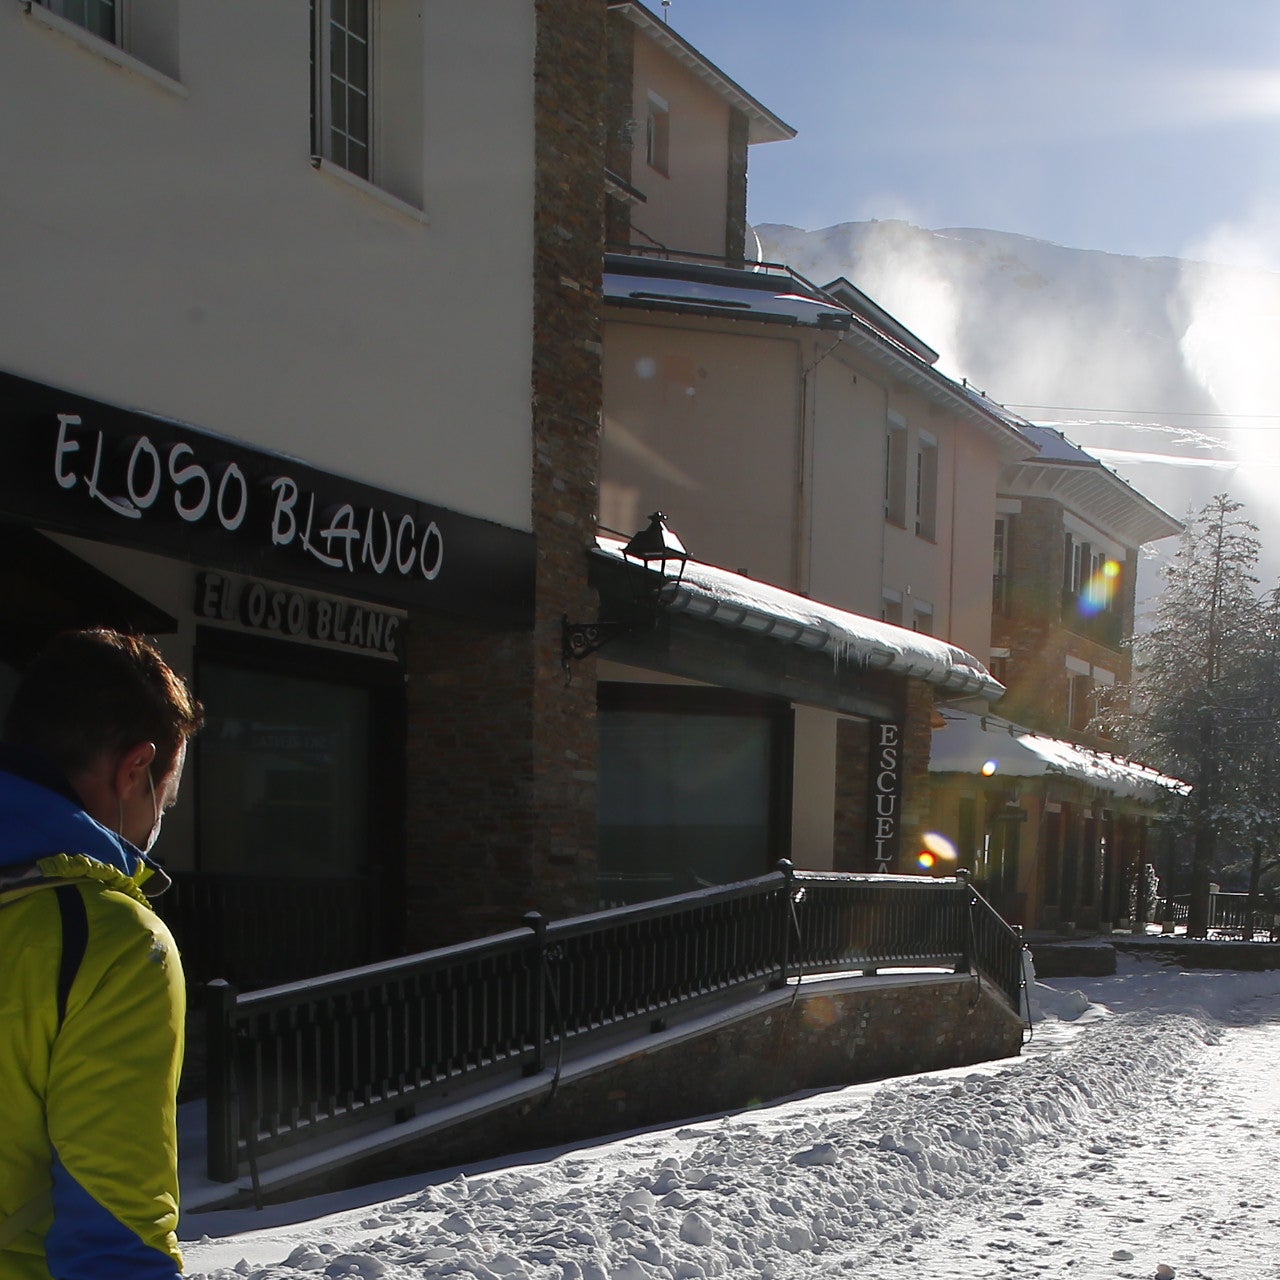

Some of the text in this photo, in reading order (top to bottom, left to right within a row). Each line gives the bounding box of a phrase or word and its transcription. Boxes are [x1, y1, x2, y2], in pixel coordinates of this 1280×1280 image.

[271, 476, 444, 581] BLANCO
[200, 571, 236, 621] EL
[246, 582, 306, 636] OSO
